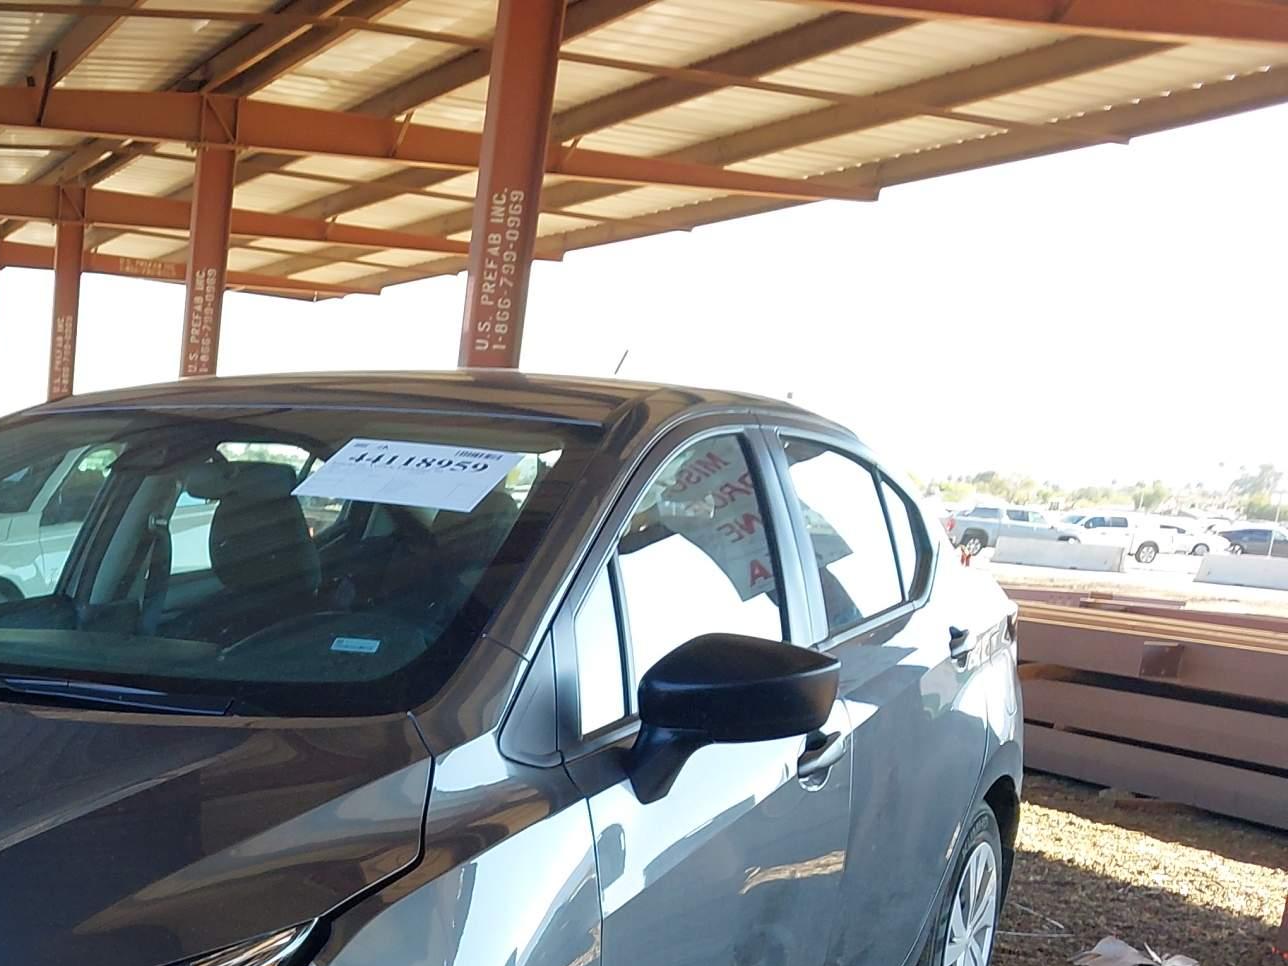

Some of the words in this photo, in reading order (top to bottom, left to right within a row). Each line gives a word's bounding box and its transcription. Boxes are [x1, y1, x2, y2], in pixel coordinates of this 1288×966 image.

[490, 187, 509, 223] INC.
[481, 232, 502, 306] PREFAB
[492, 189, 525, 351] 1-866-799-0969
[475, 317, 493, 351] U.S.
[348, 451, 490, 473] 44118959
